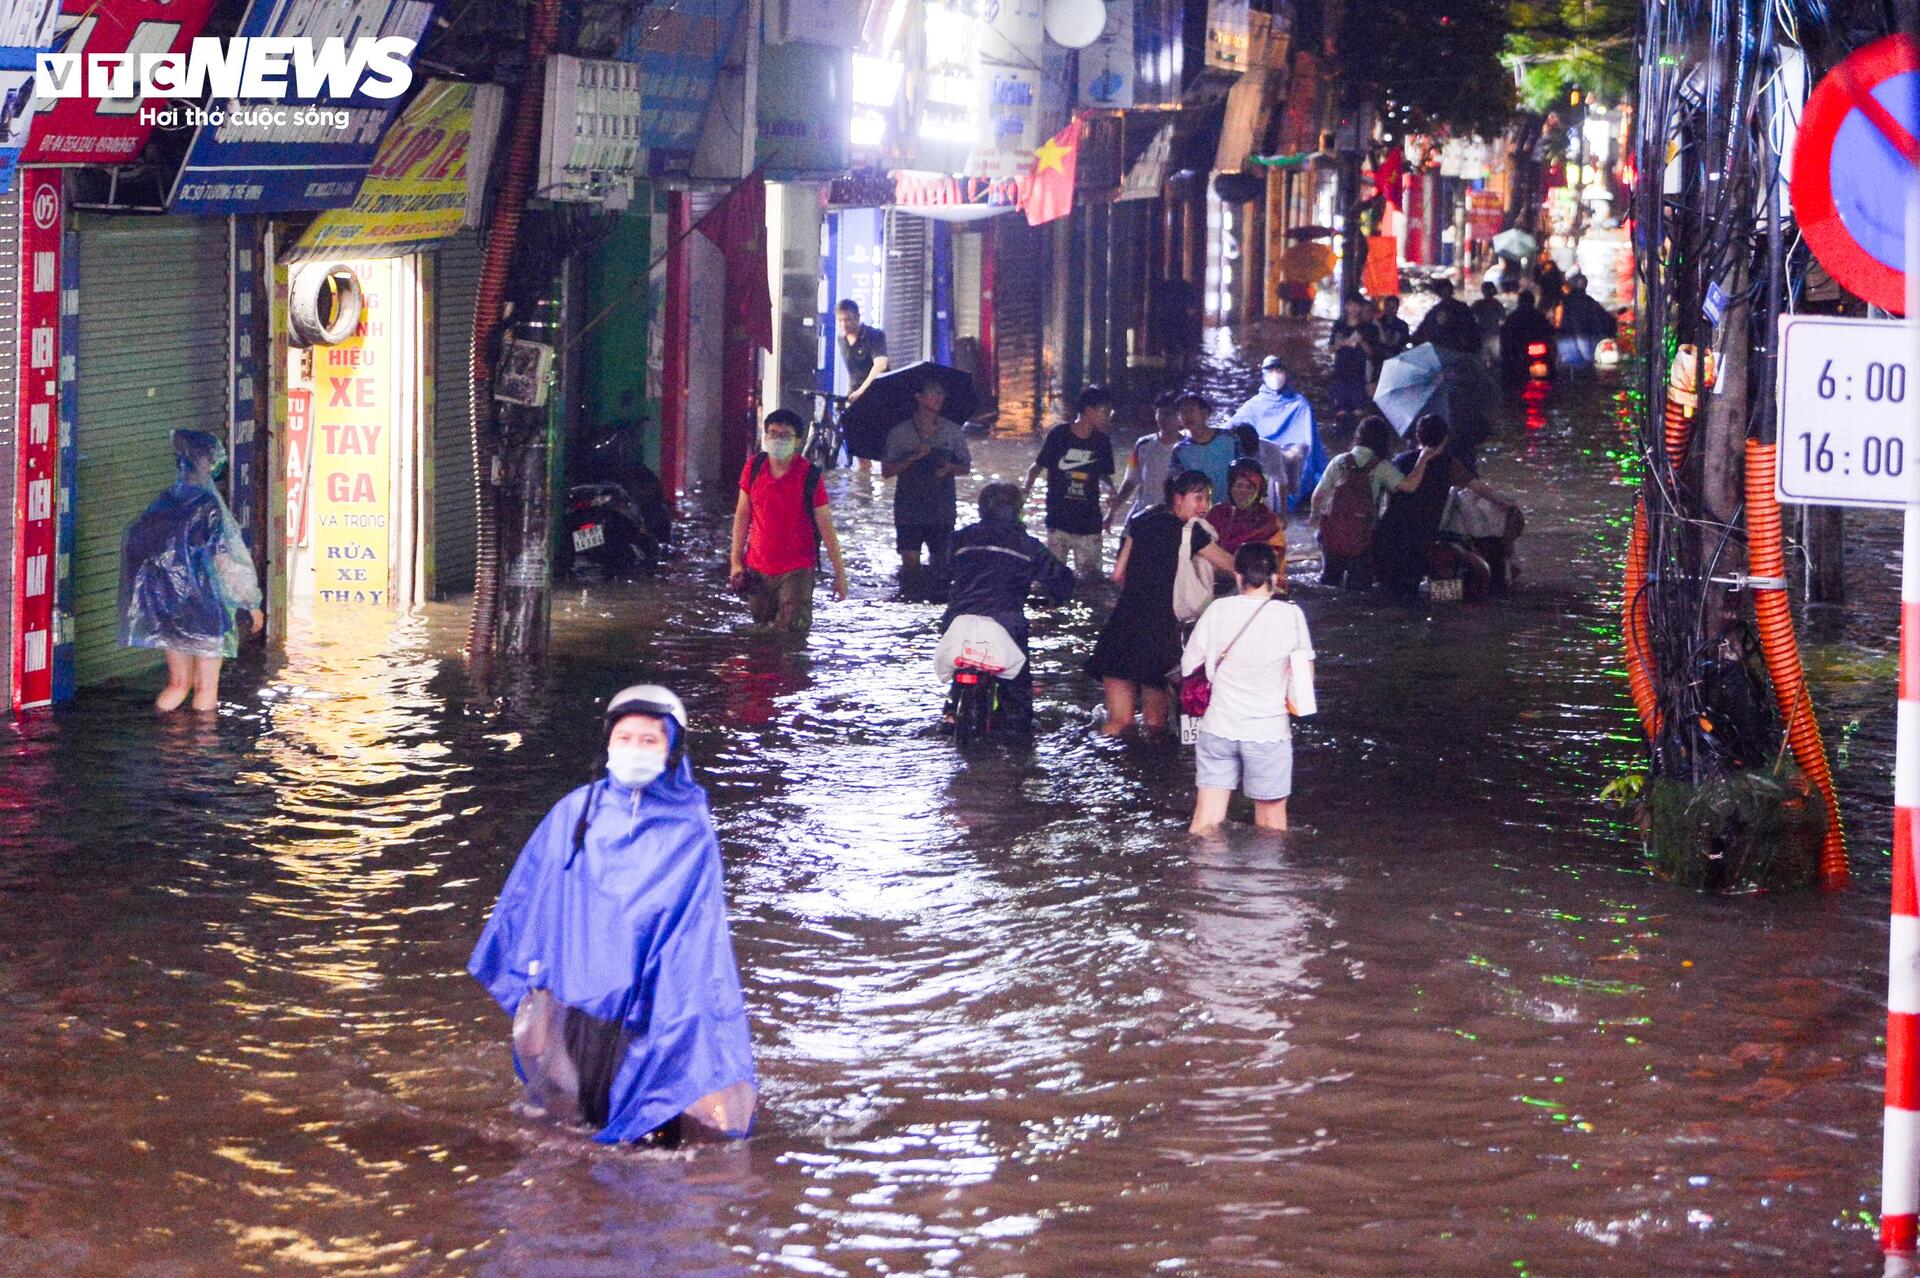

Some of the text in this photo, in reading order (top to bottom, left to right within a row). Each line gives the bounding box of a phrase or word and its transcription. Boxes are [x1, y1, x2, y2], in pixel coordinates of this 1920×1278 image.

[36, 194, 54, 220] 05
[328, 346, 375, 370] HIỆU
[329, 377, 375, 407] XE
[1817, 359, 1906, 403] 6:00
[320, 425, 382, 454] TAY
[1799, 432, 1904, 477] 16:00
[327, 472, 376, 503] GA
[344, 514, 386, 528] TRONG
[327, 542, 376, 559] RỬA
[337, 568, 367, 581] XE
[320, 590, 383, 606] THAY
